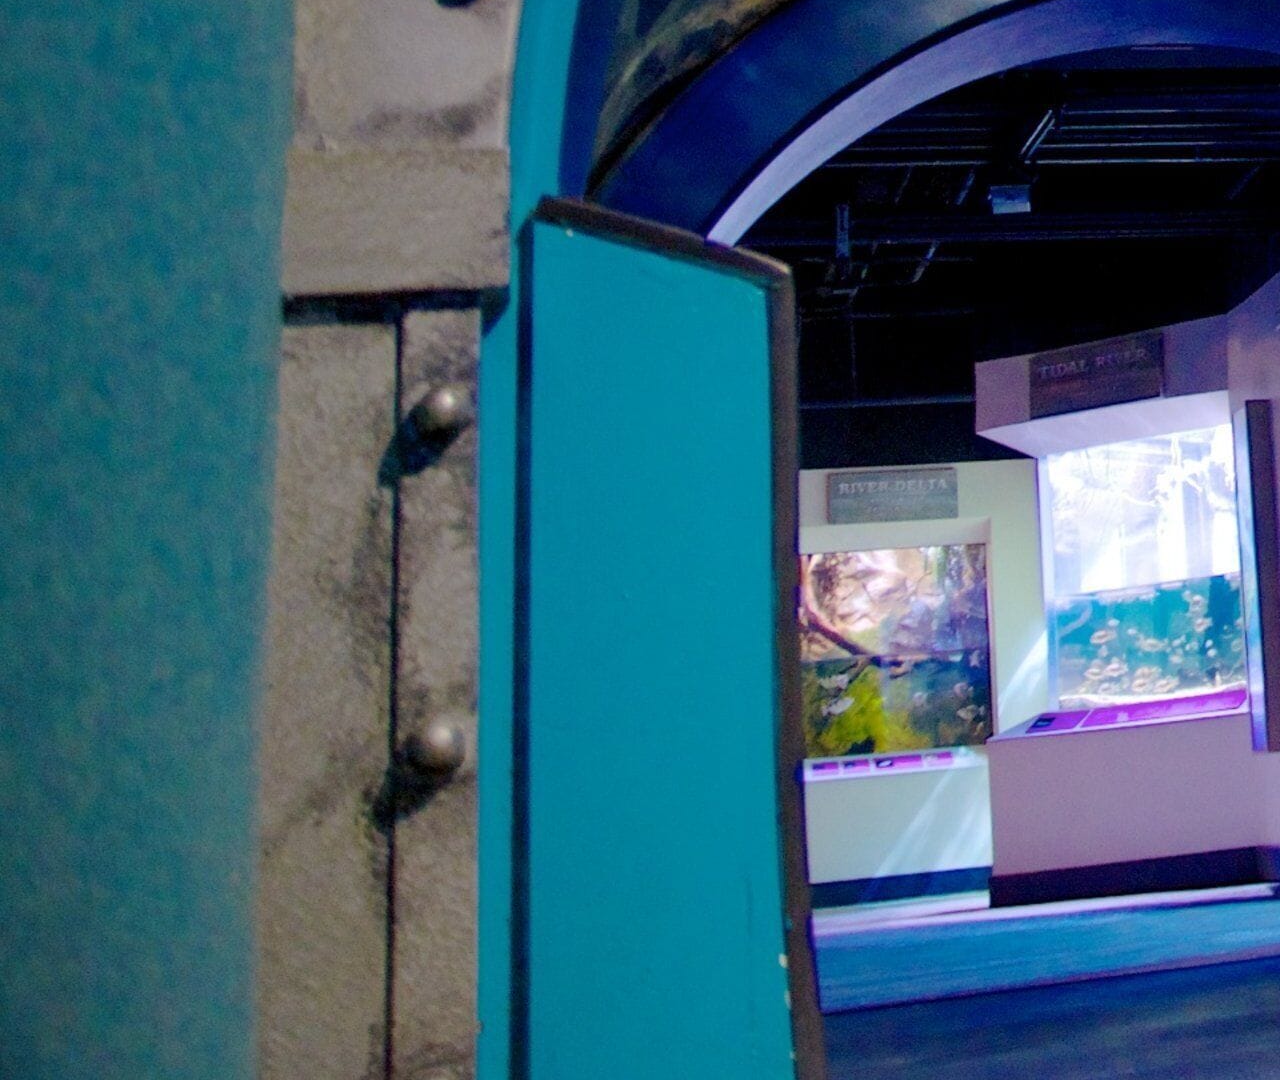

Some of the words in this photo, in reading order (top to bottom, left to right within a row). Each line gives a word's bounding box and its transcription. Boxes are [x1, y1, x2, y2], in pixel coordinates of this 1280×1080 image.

[1038, 360, 1090, 378] TIDAL
[838, 481, 887, 495] RIVER
[897, 478, 948, 492] DELTA
